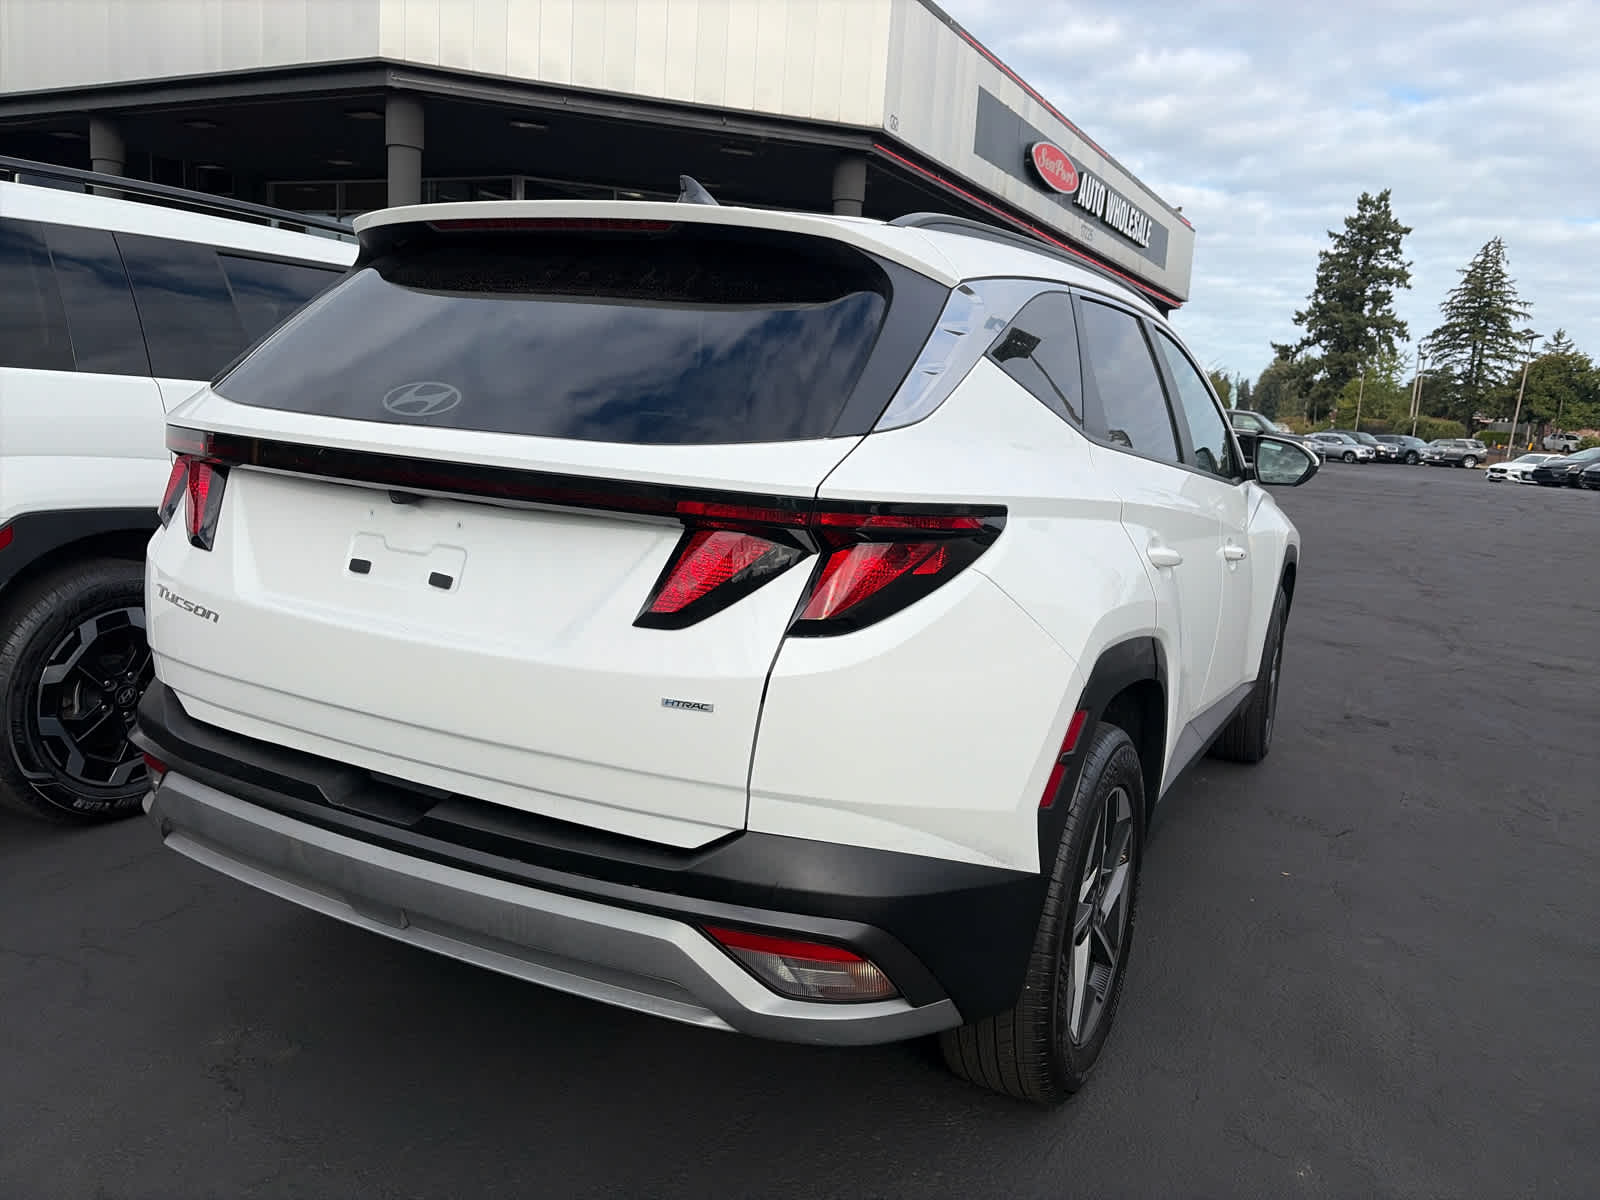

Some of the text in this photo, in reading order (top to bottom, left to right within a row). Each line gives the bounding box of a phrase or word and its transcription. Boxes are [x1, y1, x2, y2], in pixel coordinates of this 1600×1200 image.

[1077, 172, 1152, 248] AUTO WHOLESALE
[663, 698, 712, 711] HTRAC
